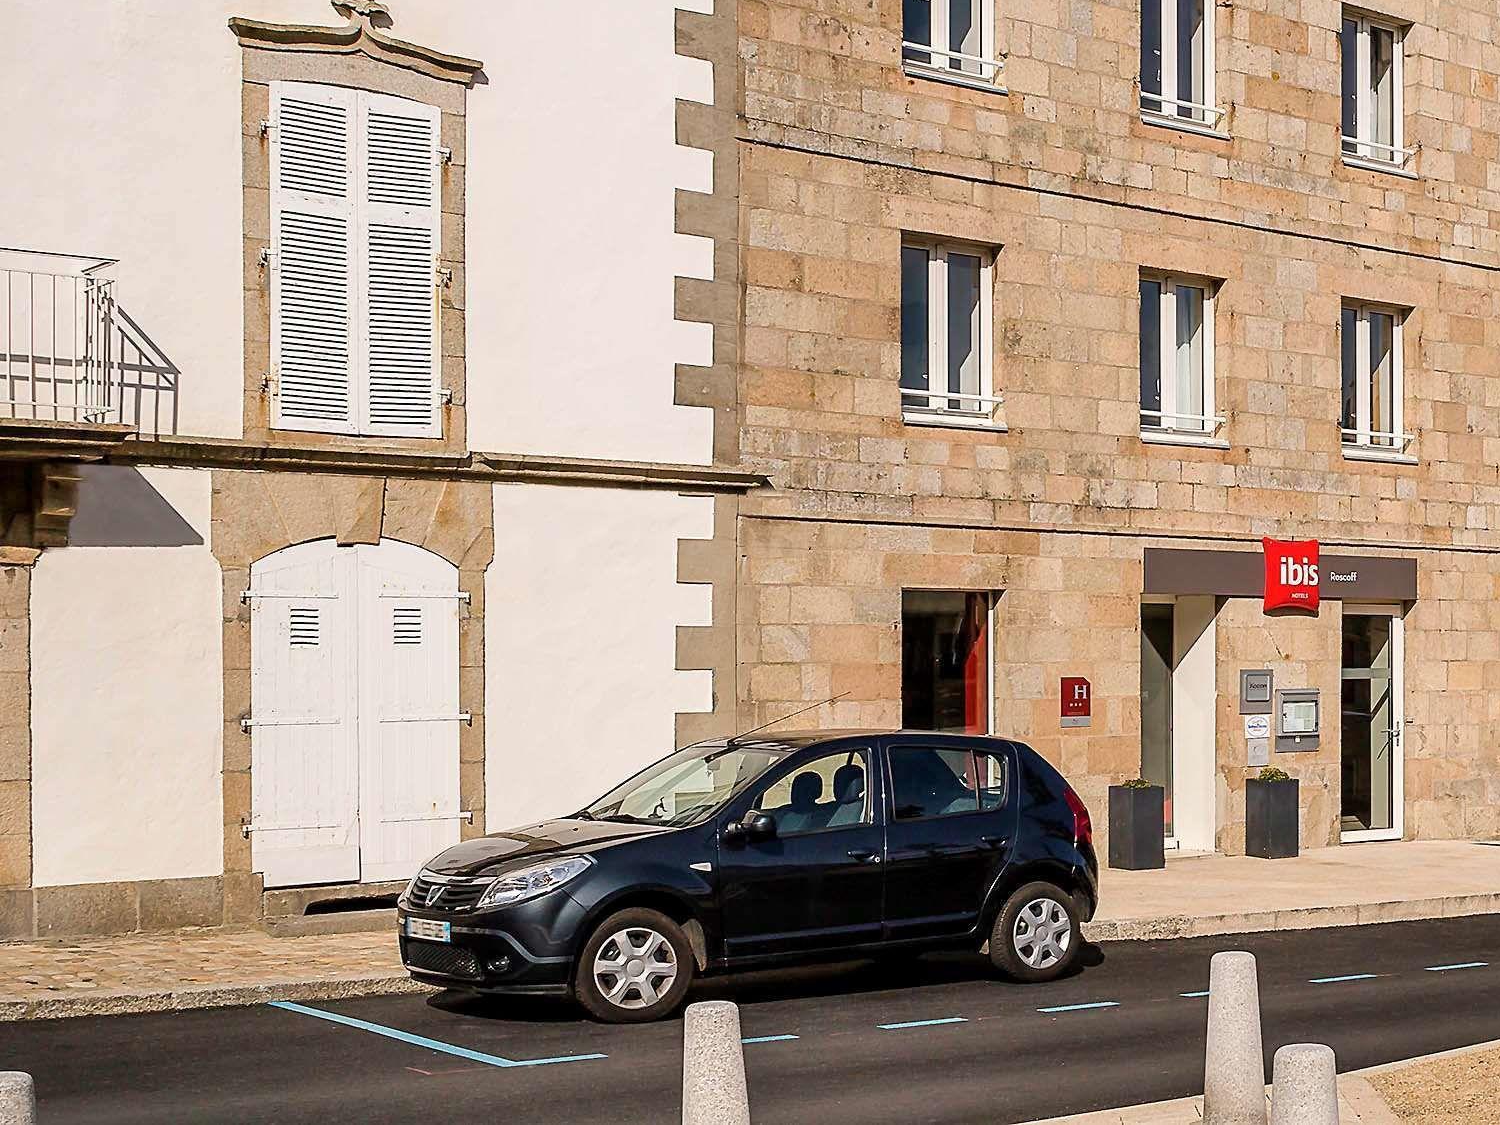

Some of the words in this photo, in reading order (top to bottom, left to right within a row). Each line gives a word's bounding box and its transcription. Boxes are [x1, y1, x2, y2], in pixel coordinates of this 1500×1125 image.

[1280, 557, 1319, 586] ibis
[1330, 572, 1357, 581] Roscoff
[1074, 685, 1087, 699] H
